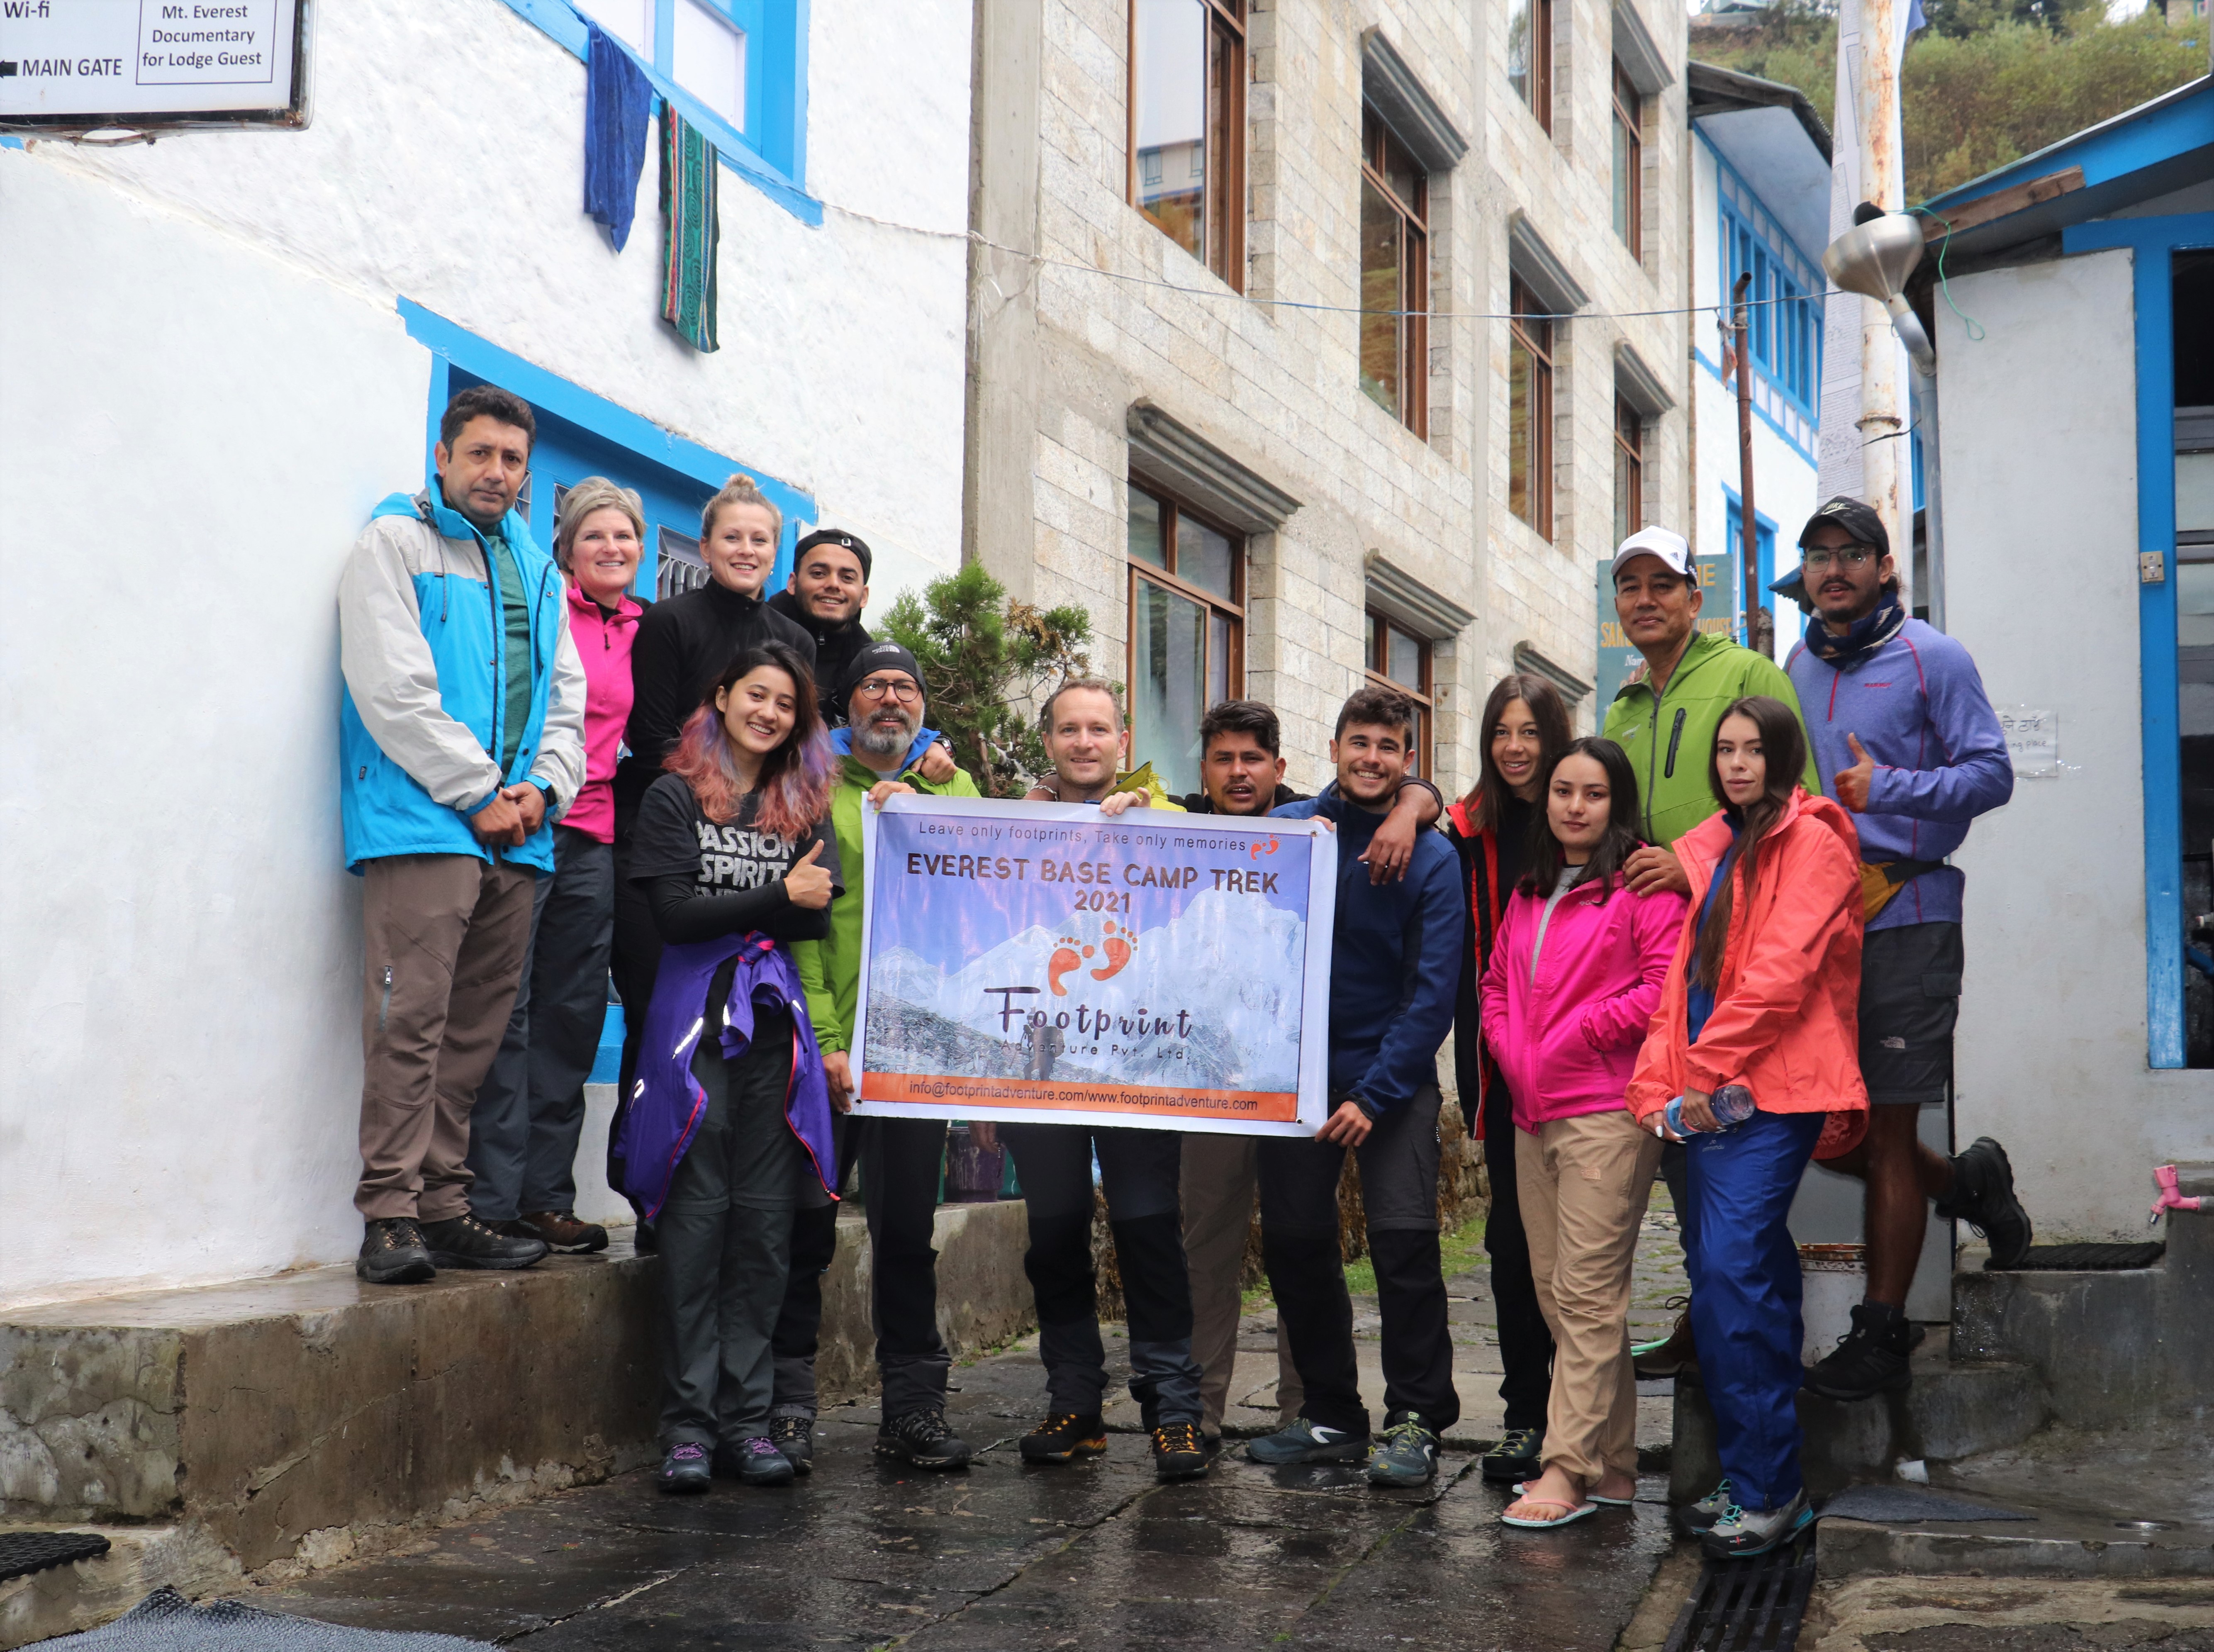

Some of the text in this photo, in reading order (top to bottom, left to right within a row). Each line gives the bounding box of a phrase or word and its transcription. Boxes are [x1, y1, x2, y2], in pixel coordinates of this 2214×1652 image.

[4, 1, 49, 18] Wi-fi
[162, 5, 248, 19] Mt. Everest
[153, 29, 255, 44] Documentary
[23, 59, 122, 76] MAIN GATE
[143, 52, 261, 69] for Lodge Guest
[920, 821, 1245, 851] Leave only footprints, Take only memories
[698, 853, 787, 889] SPIRIT
[907, 853, 1278, 894] EVEREST BASE CAMP TREK
[1074, 889, 1131, 914] 2021
[984, 987, 1192, 1040] Footprint
[1001, 1039, 1191, 1060] Adventure Pvt. Ltd.
